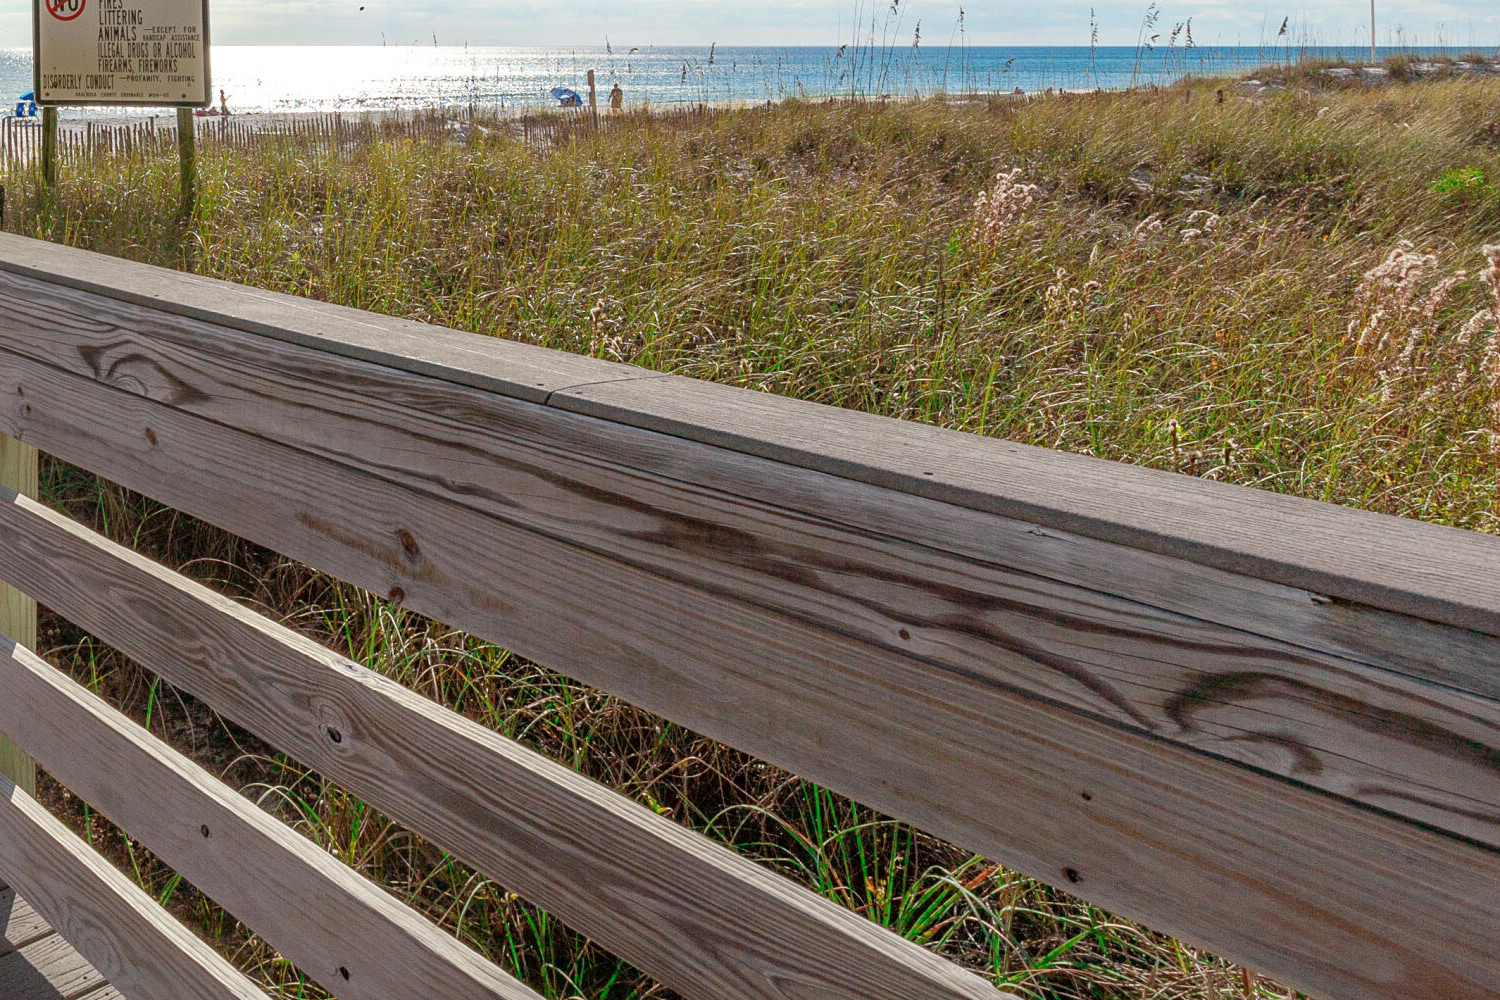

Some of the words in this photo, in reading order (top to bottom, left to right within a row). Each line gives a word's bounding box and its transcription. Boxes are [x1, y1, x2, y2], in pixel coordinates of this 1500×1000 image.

[99, 10, 142, 24] LITTERING
[98, 26, 136, 41] ANIMALS
[98, 43, 124, 58] ILLEGAL
[128, 43, 149, 58] DRUGS
[153, 42, 161, 58] OR
[166, 42, 196, 58] ALCOHOL
[98, 60, 134, 73] FIREARMS,
[139, 60, 178, 72] FIREWORKS
[43, 75, 81, 89] DISORDERLY
[86, 74, 114, 89] CONDUCT
